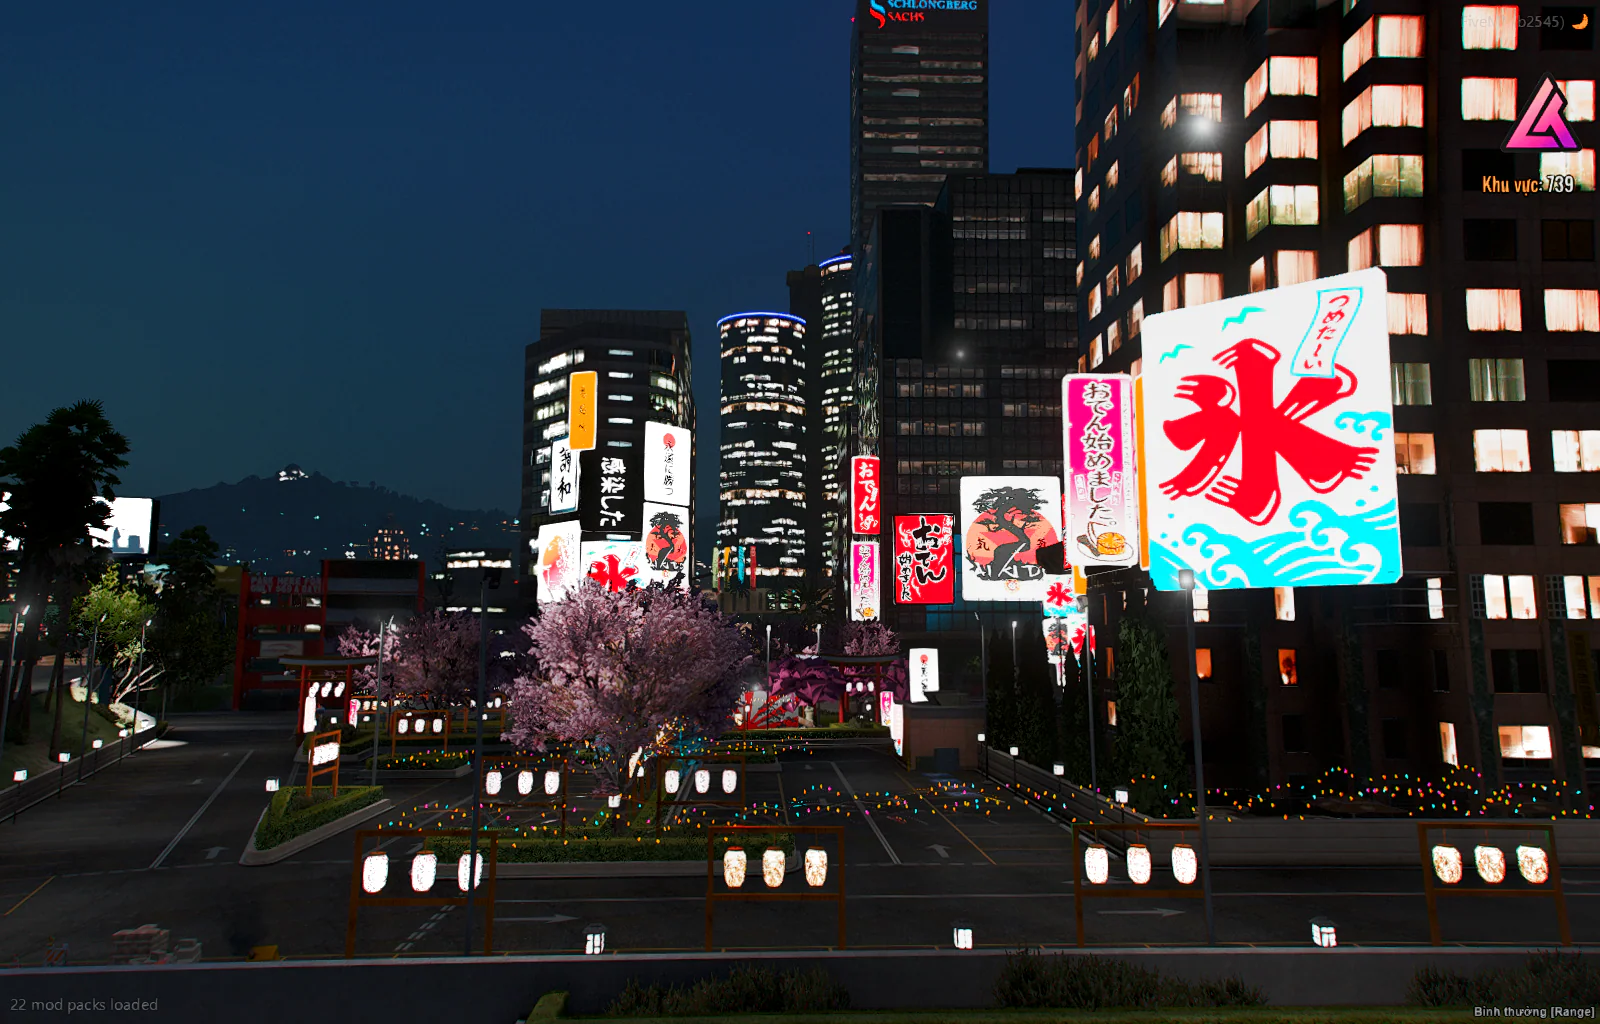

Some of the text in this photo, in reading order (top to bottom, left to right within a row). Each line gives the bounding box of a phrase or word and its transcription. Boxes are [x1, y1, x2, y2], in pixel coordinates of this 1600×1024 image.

[887, 0, 978, 10] SCHLONGBERG
[887, 12, 925, 22] SACHS
[1159, 337, 1380, 526] 氷
[912, 515, 947, 585] おでん
